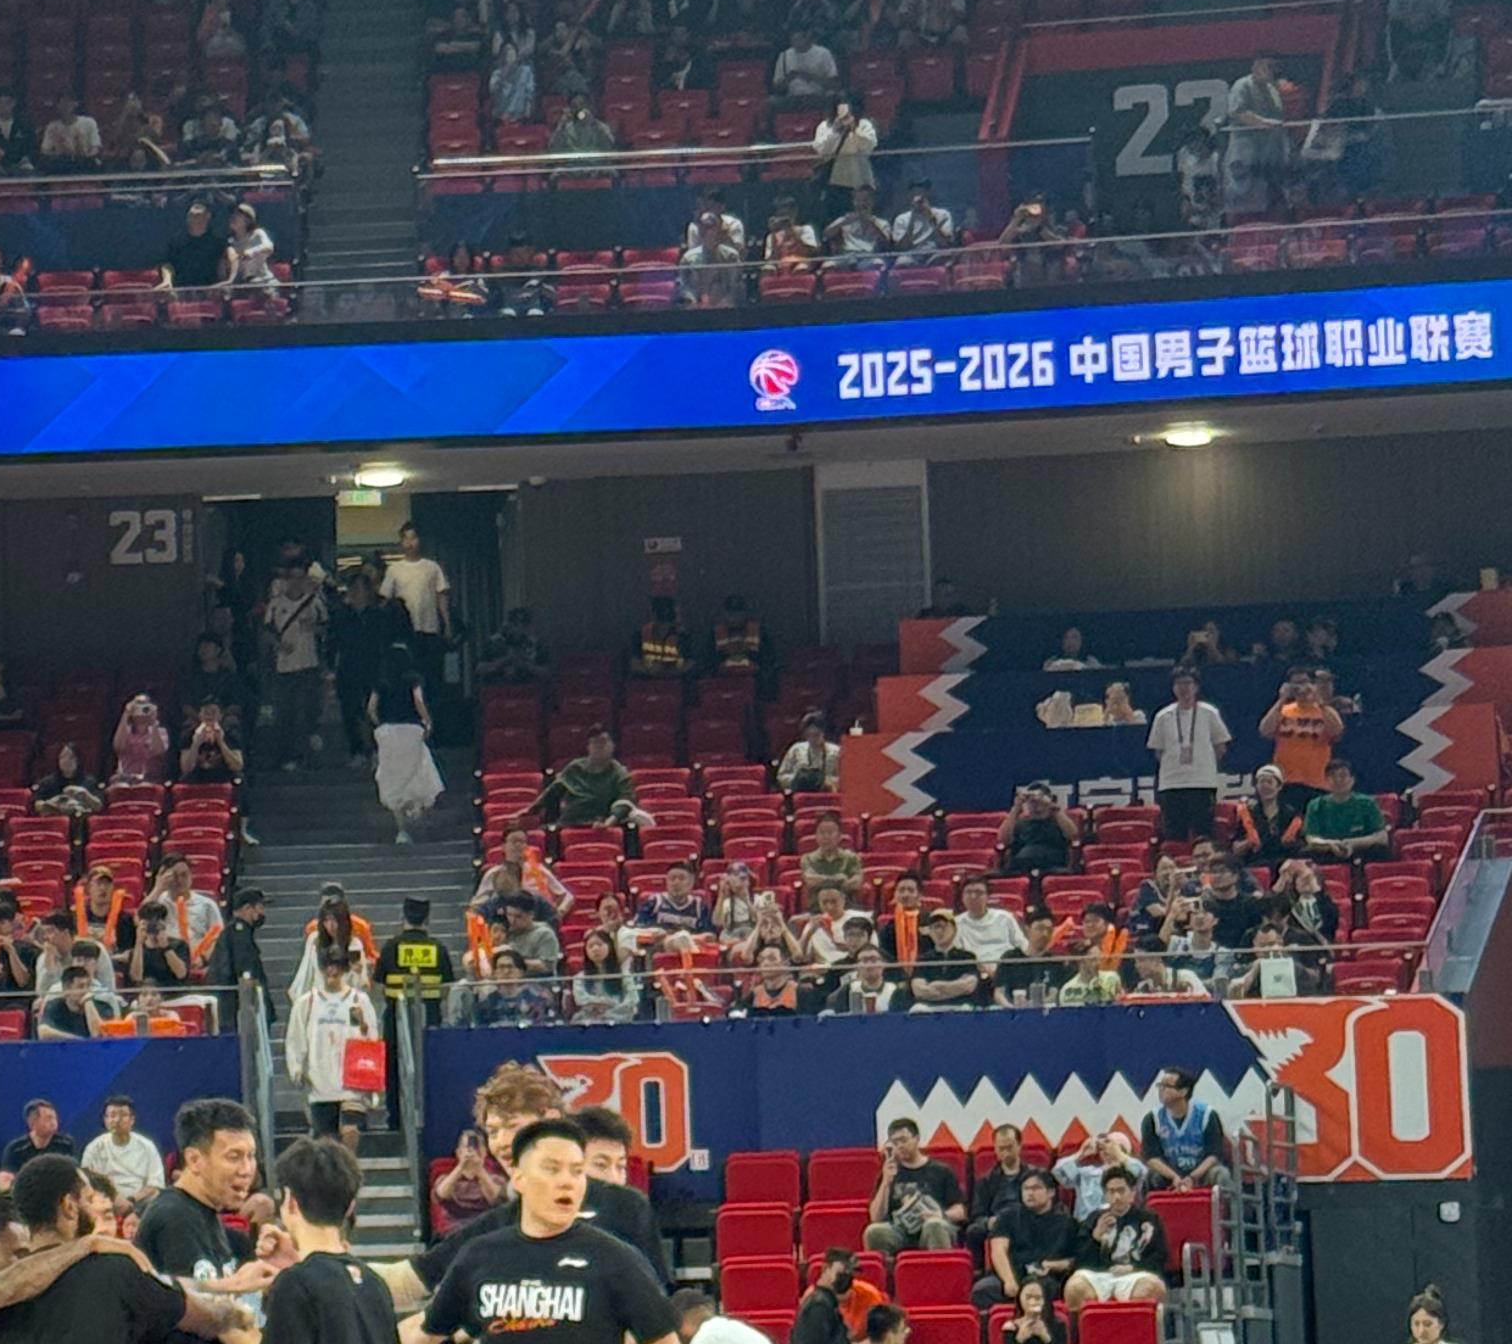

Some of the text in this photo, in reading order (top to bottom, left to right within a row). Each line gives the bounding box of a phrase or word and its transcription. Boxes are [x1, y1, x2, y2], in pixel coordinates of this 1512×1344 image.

[838, 312, 1492, 399] 2025-2026 中国男子篮球职业联赛
[108, 510, 177, 565] 23
[479, 1283, 585, 1322] SHANGHAI
